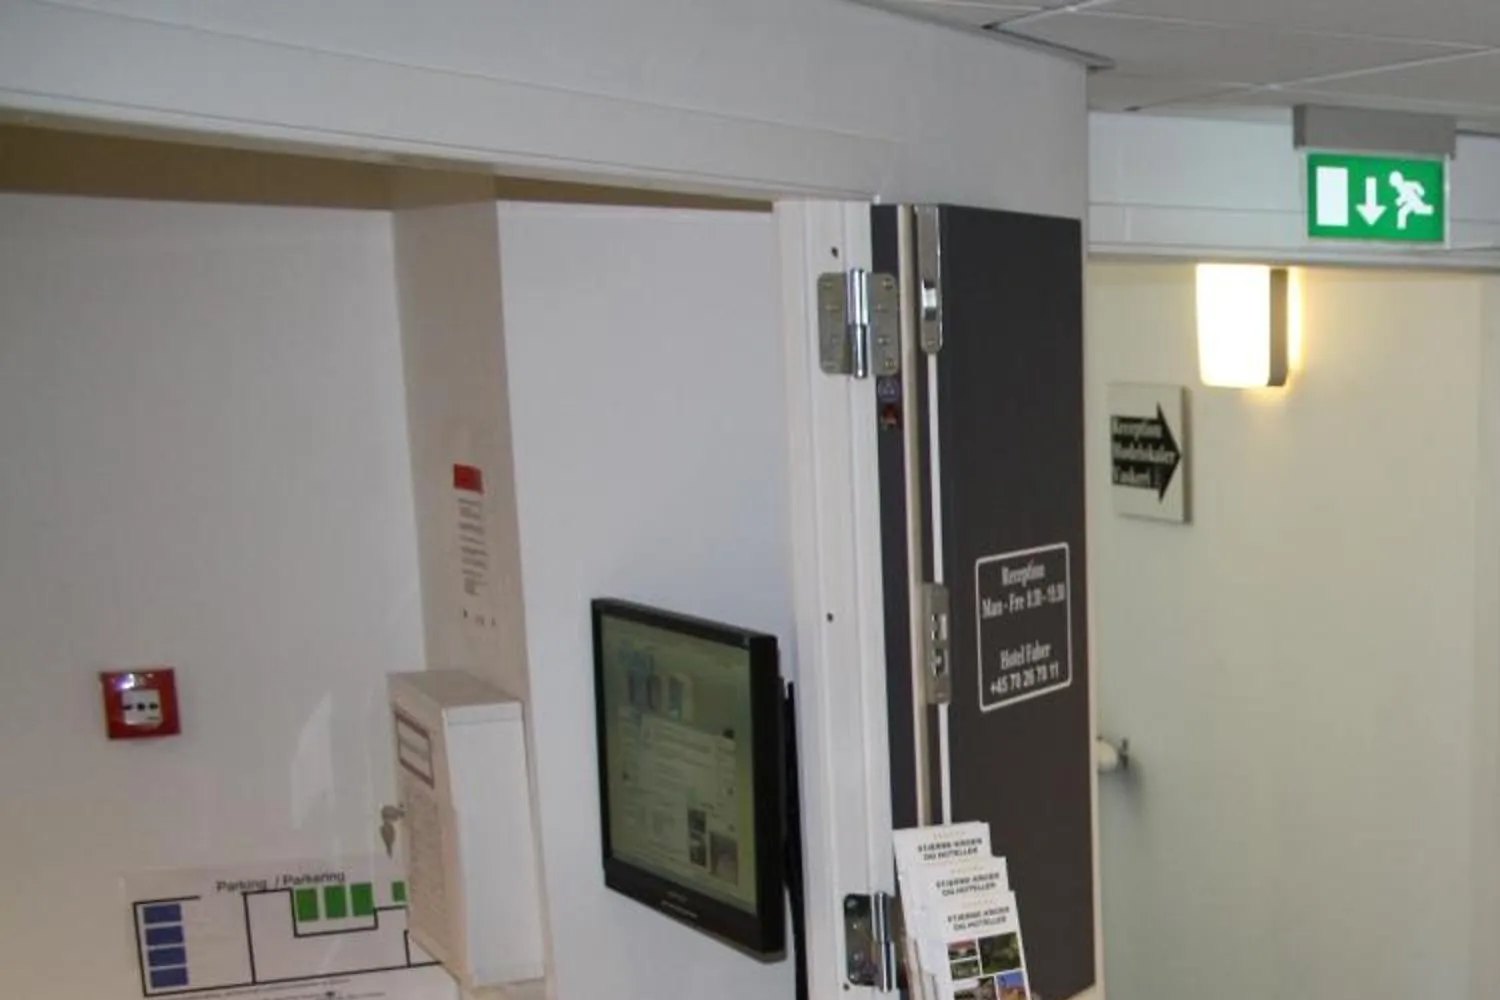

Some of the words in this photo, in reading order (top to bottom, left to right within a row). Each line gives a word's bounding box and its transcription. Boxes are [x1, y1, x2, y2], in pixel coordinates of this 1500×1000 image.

[1001, 559, 1046, 588] Reception
[1000, 644, 1026, 670] Hotel
[215, 879, 267, 893] Parking
[283, 871, 346, 886] Parkering
